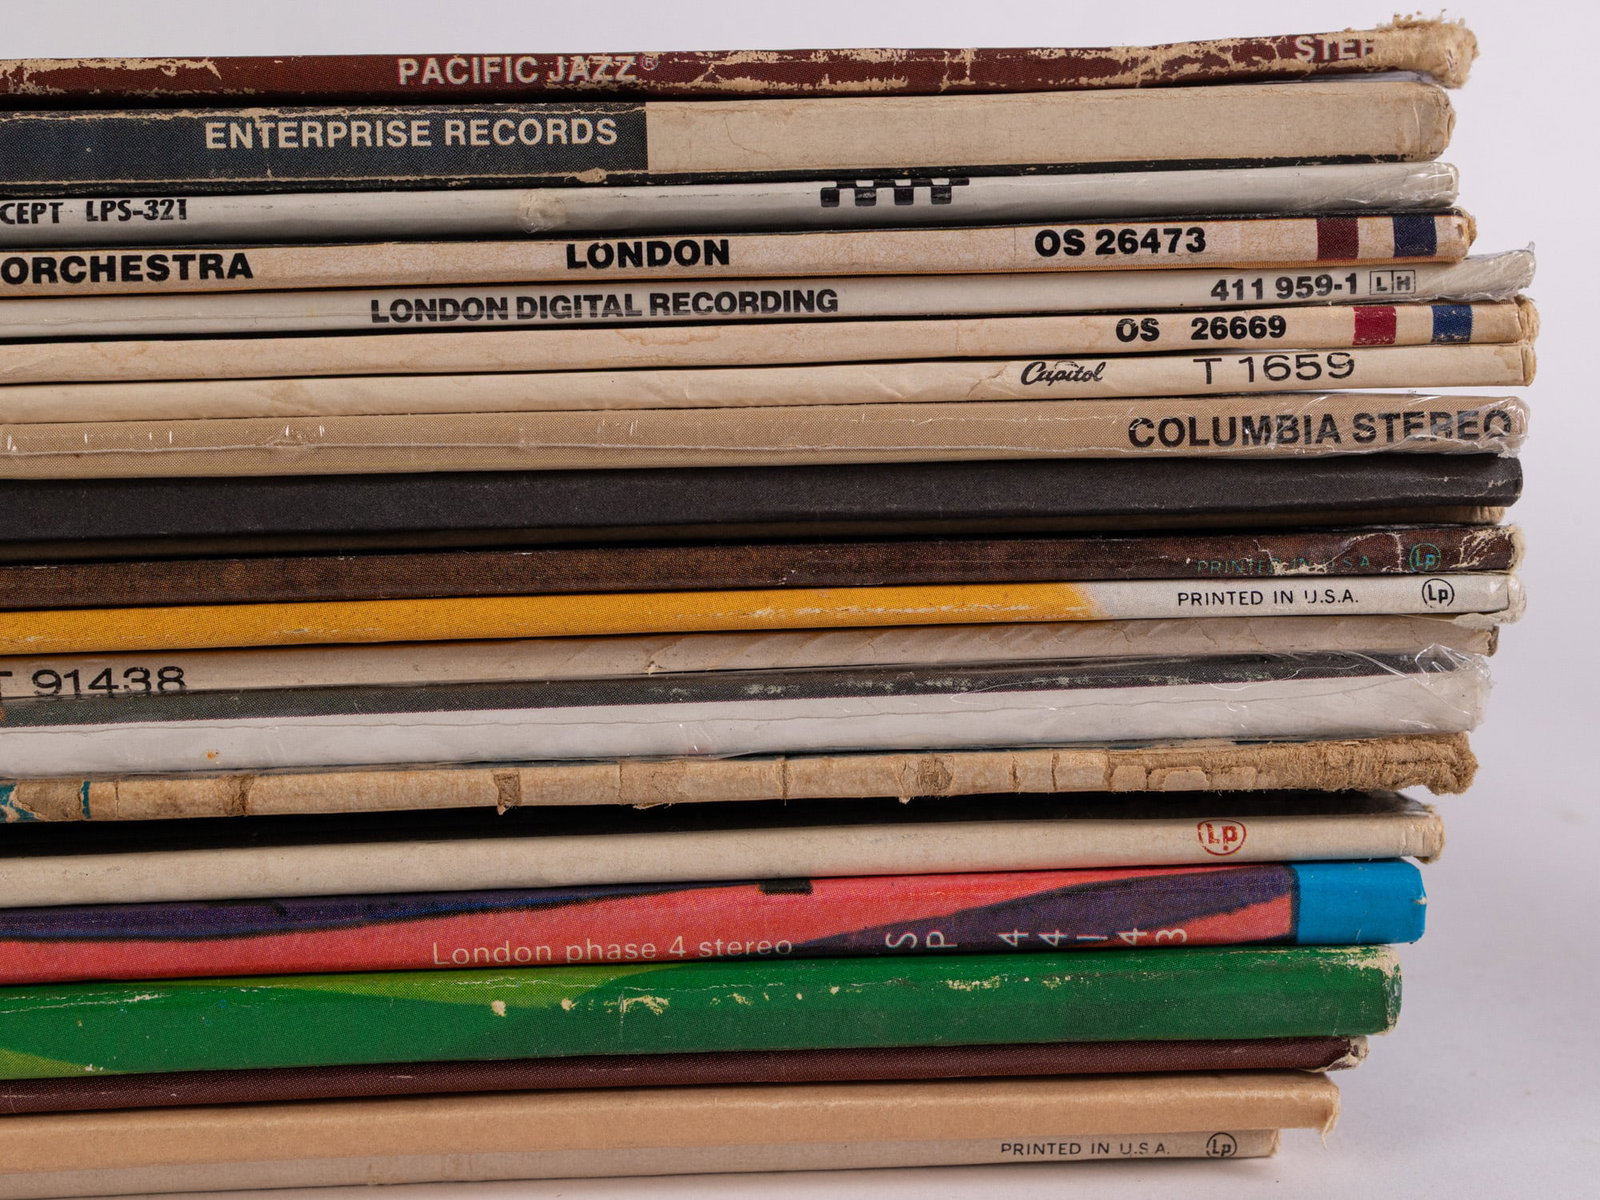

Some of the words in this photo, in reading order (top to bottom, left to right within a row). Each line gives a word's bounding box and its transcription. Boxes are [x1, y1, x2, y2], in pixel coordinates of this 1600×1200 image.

[398, 56, 539, 85] PACIFIC
[205, 120, 432, 149] ENTERPRISE
[444, 118, 618, 147] RECORDS
[0, 202, 64, 225] CEPT
[86, 198, 188, 222] LPS-321
[566, 239, 730, 269] LONDON
[1034, 228, 1085, 257] OS
[1095, 226, 1207, 255] 26473
[1, 252, 254, 285] ORCHESTRA
[1211, 278, 1268, 301] 411
[1275, 272, 1358, 297] 959-1
[371, 296, 508, 323] LONDON
[516, 293, 642, 320] DIGITAL
[650, 288, 838, 316] RECORDING
[1115, 318, 1160, 342] OS
[1190, 315, 1287, 340] 26669
[1021, 361, 1107, 387] Capitol
[1193, 358, 1222, 385] T
[1238, 352, 1355, 384] 1659
[1128, 413, 1343, 447] COLUMBIA
[1352, 409, 1512, 443] STEREO
[1178, 590, 1263, 606] PRINTED
[1274, 589, 1294, 604] IN
[1304, 588, 1359, 605] U.S.A.
[31, 665, 187, 699] 91438
[432, 940, 552, 967] London
[566, 937, 656, 964] phase
[669, 935, 687, 958] 4
[698, 937, 793, 958] stereo
[1001, 1142, 1082, 1156] PRINTED
[1090, 1142, 1110, 1155] IN
